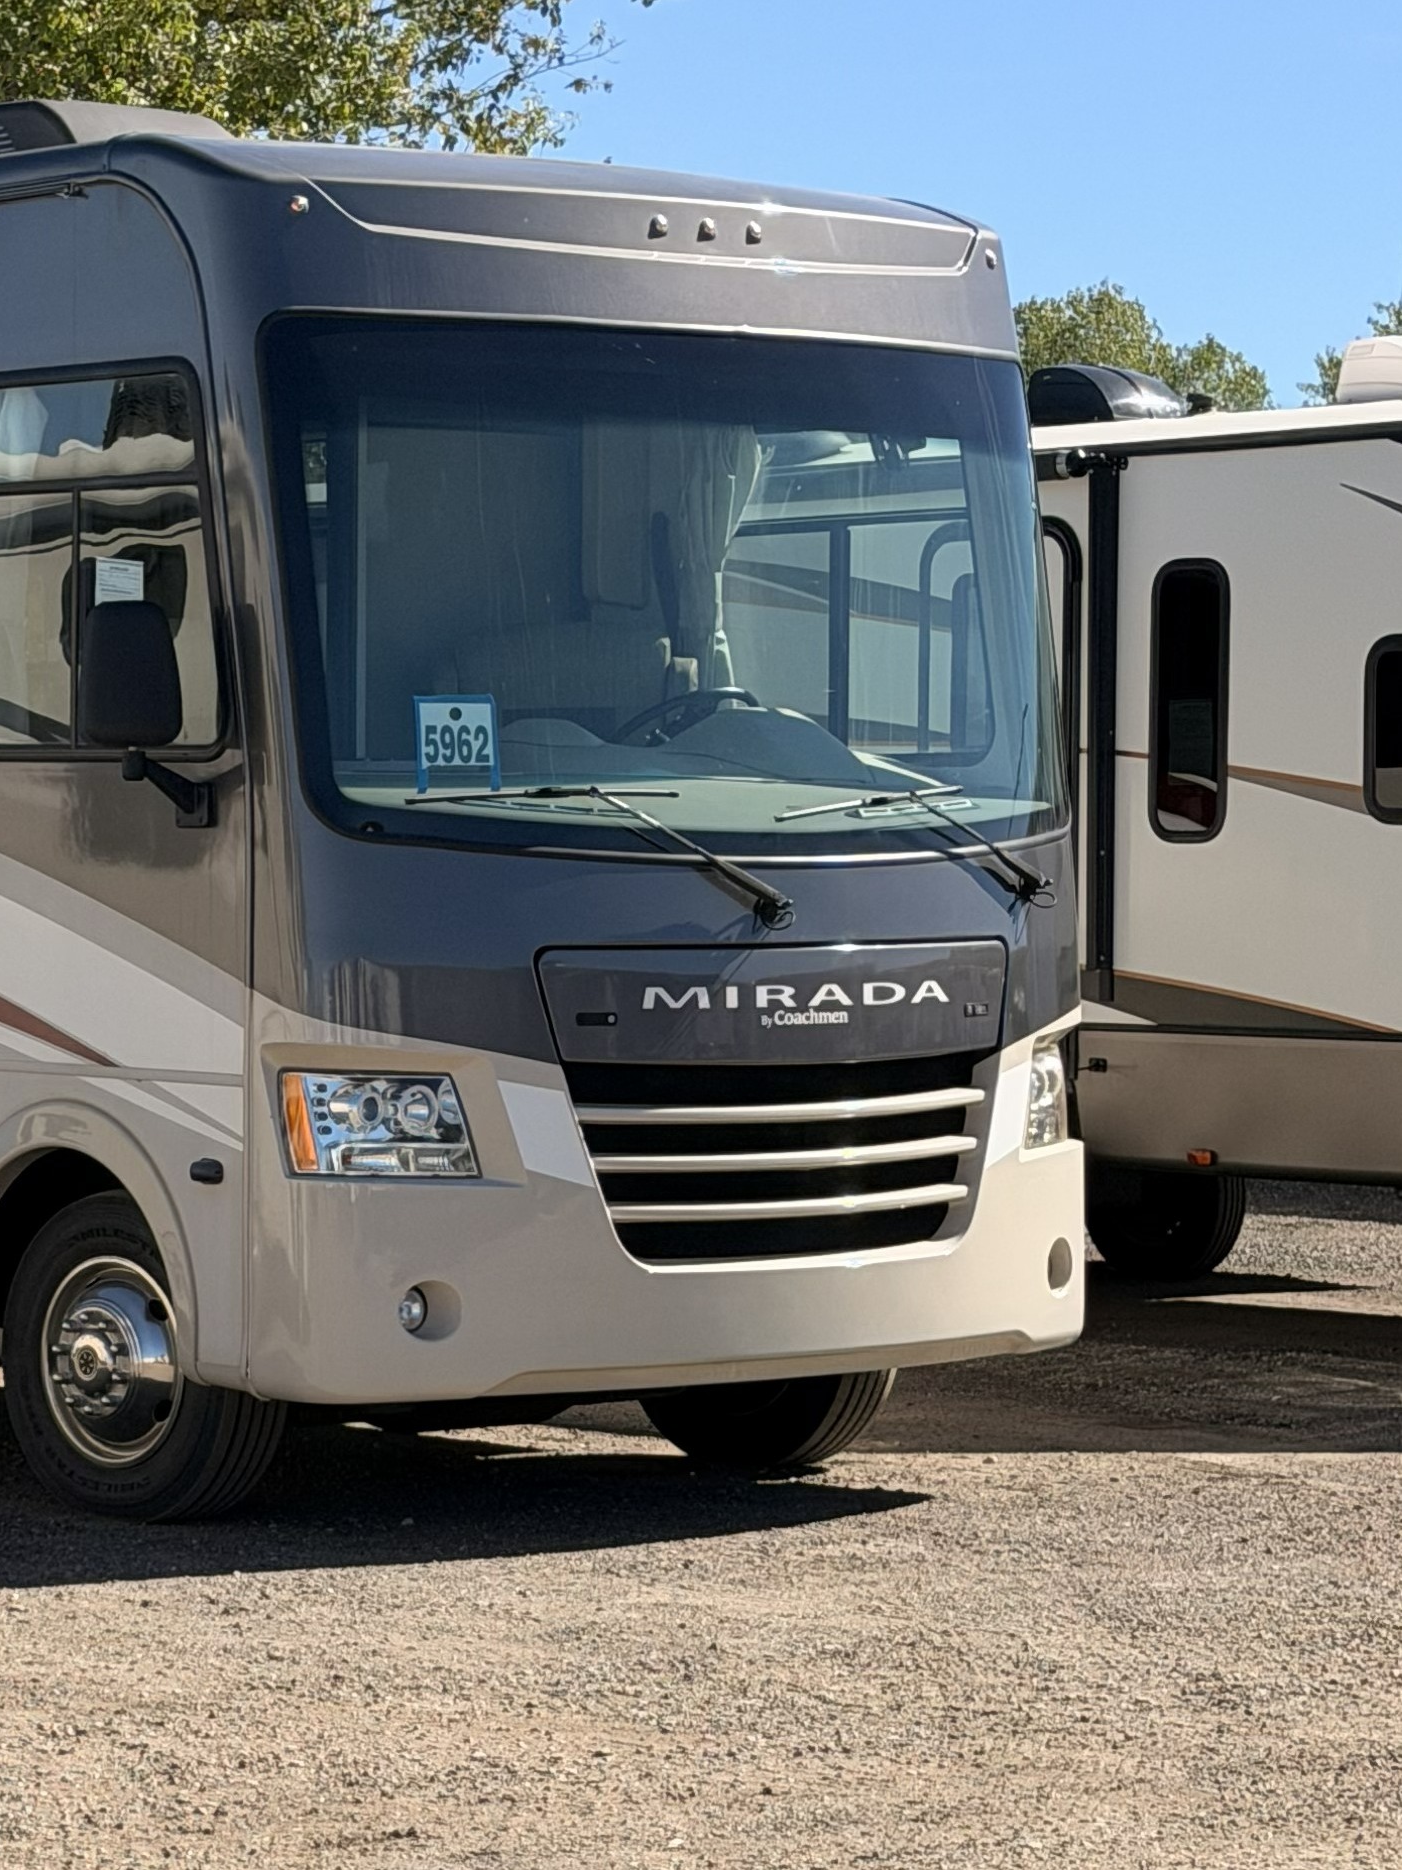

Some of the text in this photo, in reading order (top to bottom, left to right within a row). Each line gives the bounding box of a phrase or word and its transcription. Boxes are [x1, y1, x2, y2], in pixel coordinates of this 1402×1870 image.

[424, 725, 490, 764] 5962
[642, 980, 949, 1009] MIRADA
[761, 1008, 848, 1029] By Coachmen
